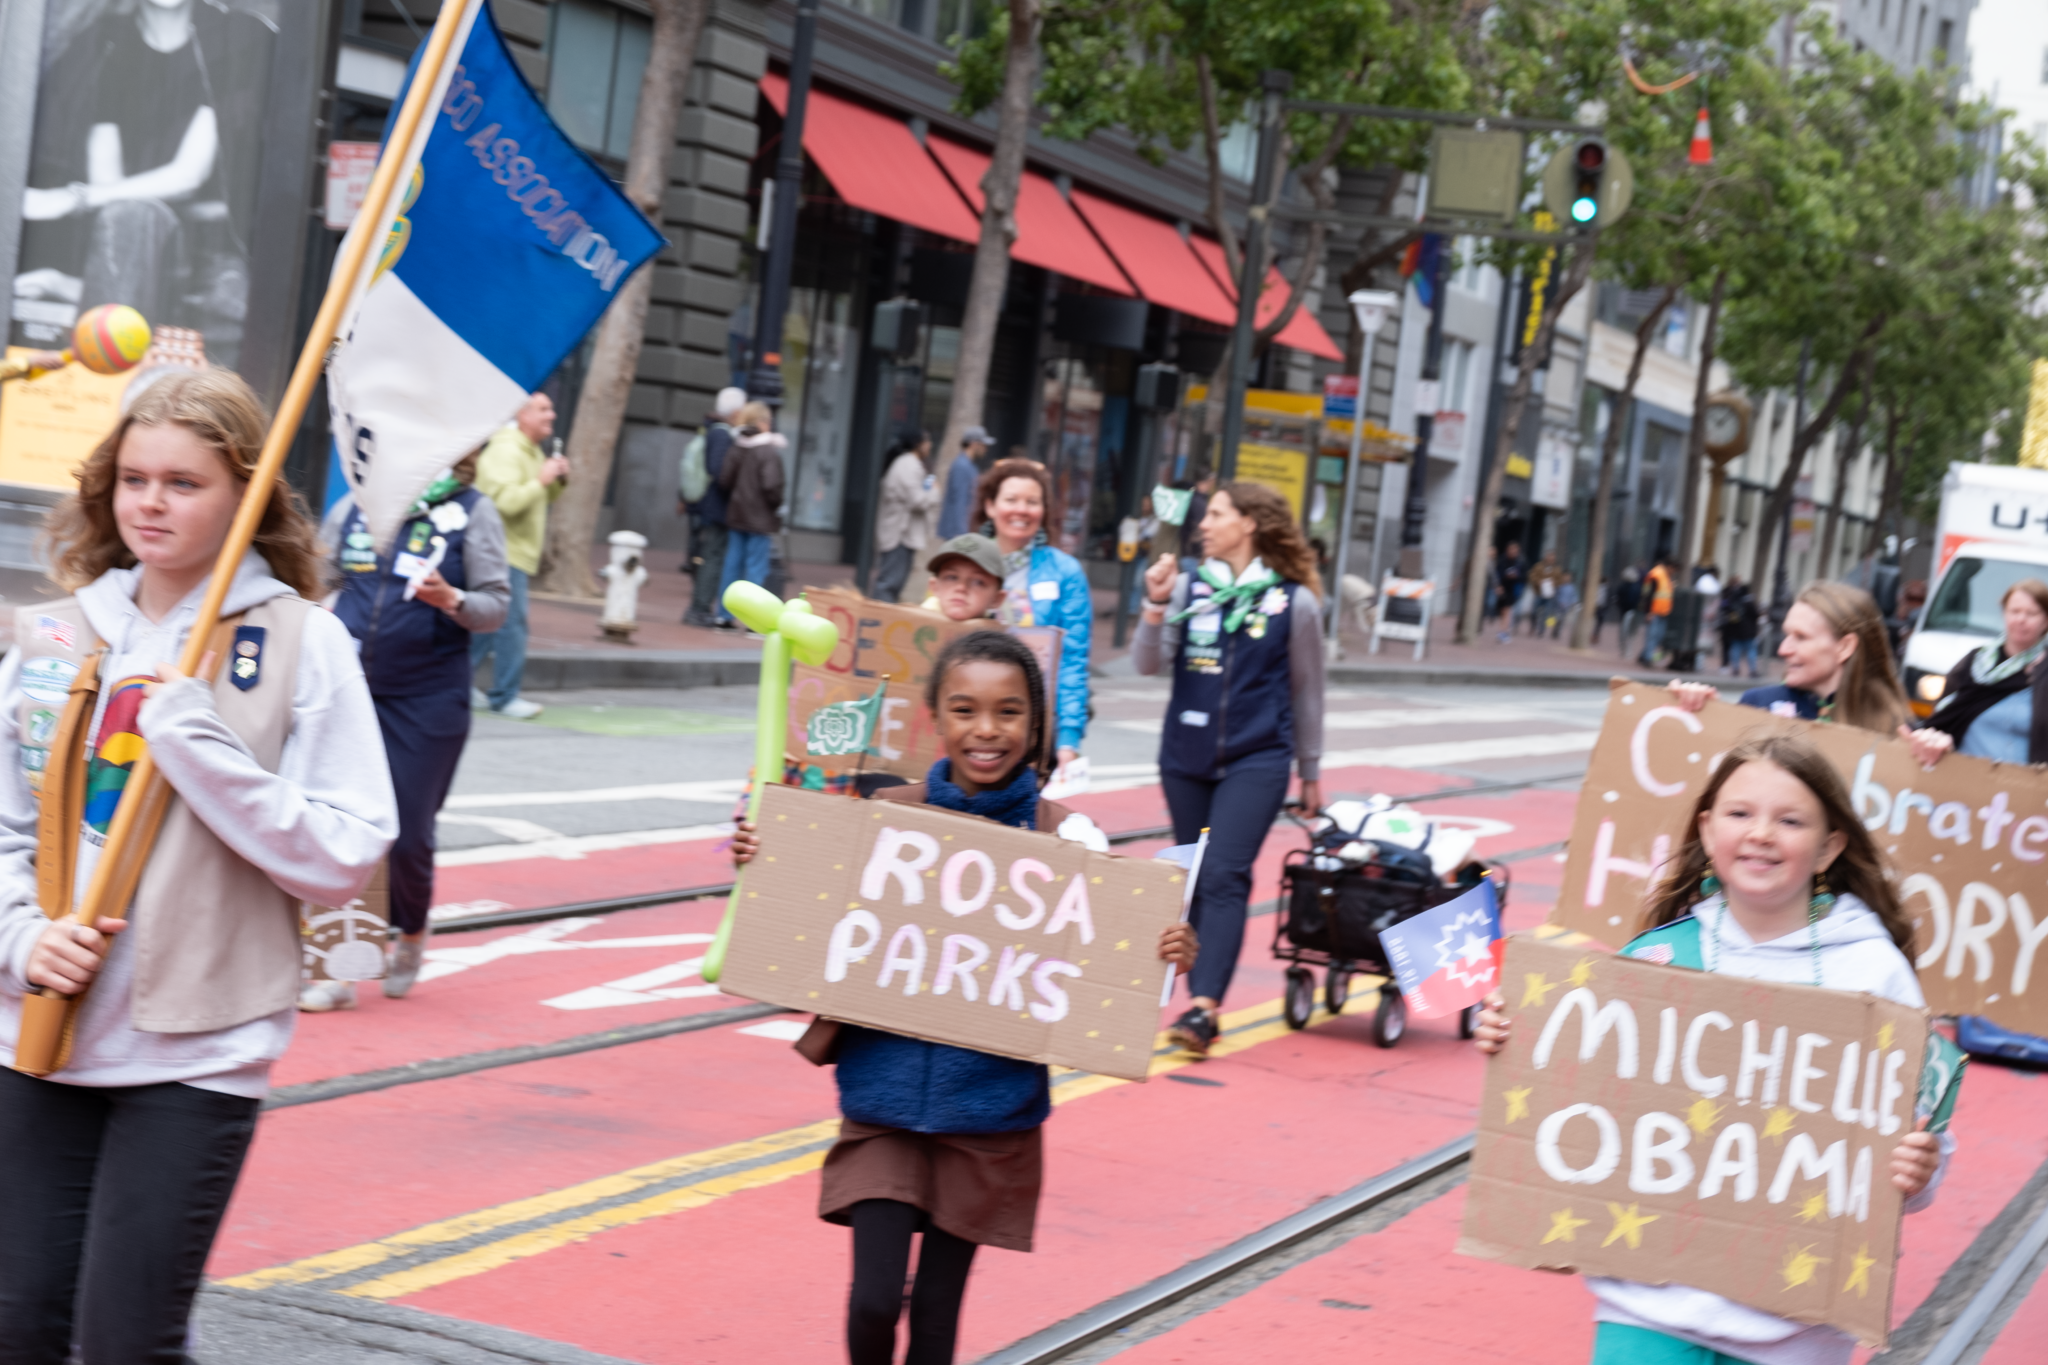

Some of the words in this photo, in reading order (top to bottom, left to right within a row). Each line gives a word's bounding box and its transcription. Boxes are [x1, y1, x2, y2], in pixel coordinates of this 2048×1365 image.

[464, 122, 631, 292] ASSOCIATION
[859, 826, 1095, 945] ROSA
[824, 909, 1083, 1023] PARKS
[1532, 987, 1906, 1136] MICHELLE
[1535, 1103, 1873, 1223] OBAMA
